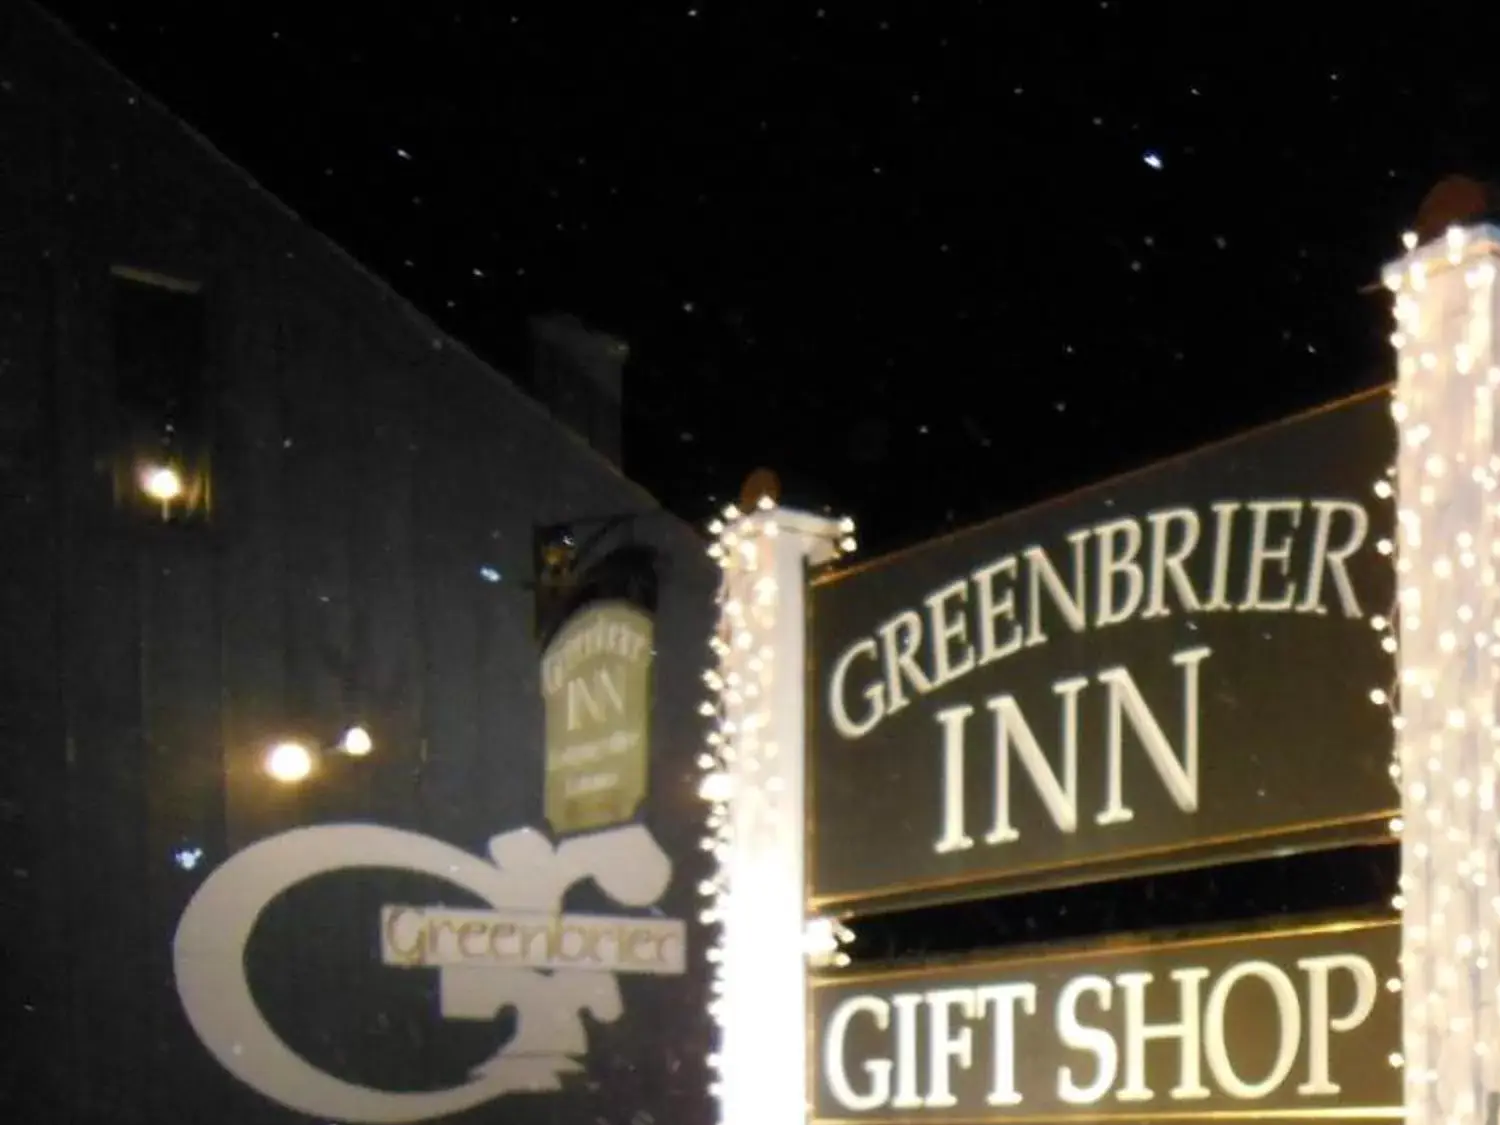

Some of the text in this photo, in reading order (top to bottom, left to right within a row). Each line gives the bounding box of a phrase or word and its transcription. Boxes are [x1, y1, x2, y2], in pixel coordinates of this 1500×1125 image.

[829, 497, 1370, 740] GREENBRIER
[934, 645, 1212, 855] INN
[824, 952, 1377, 1112] GIFT SHOP
